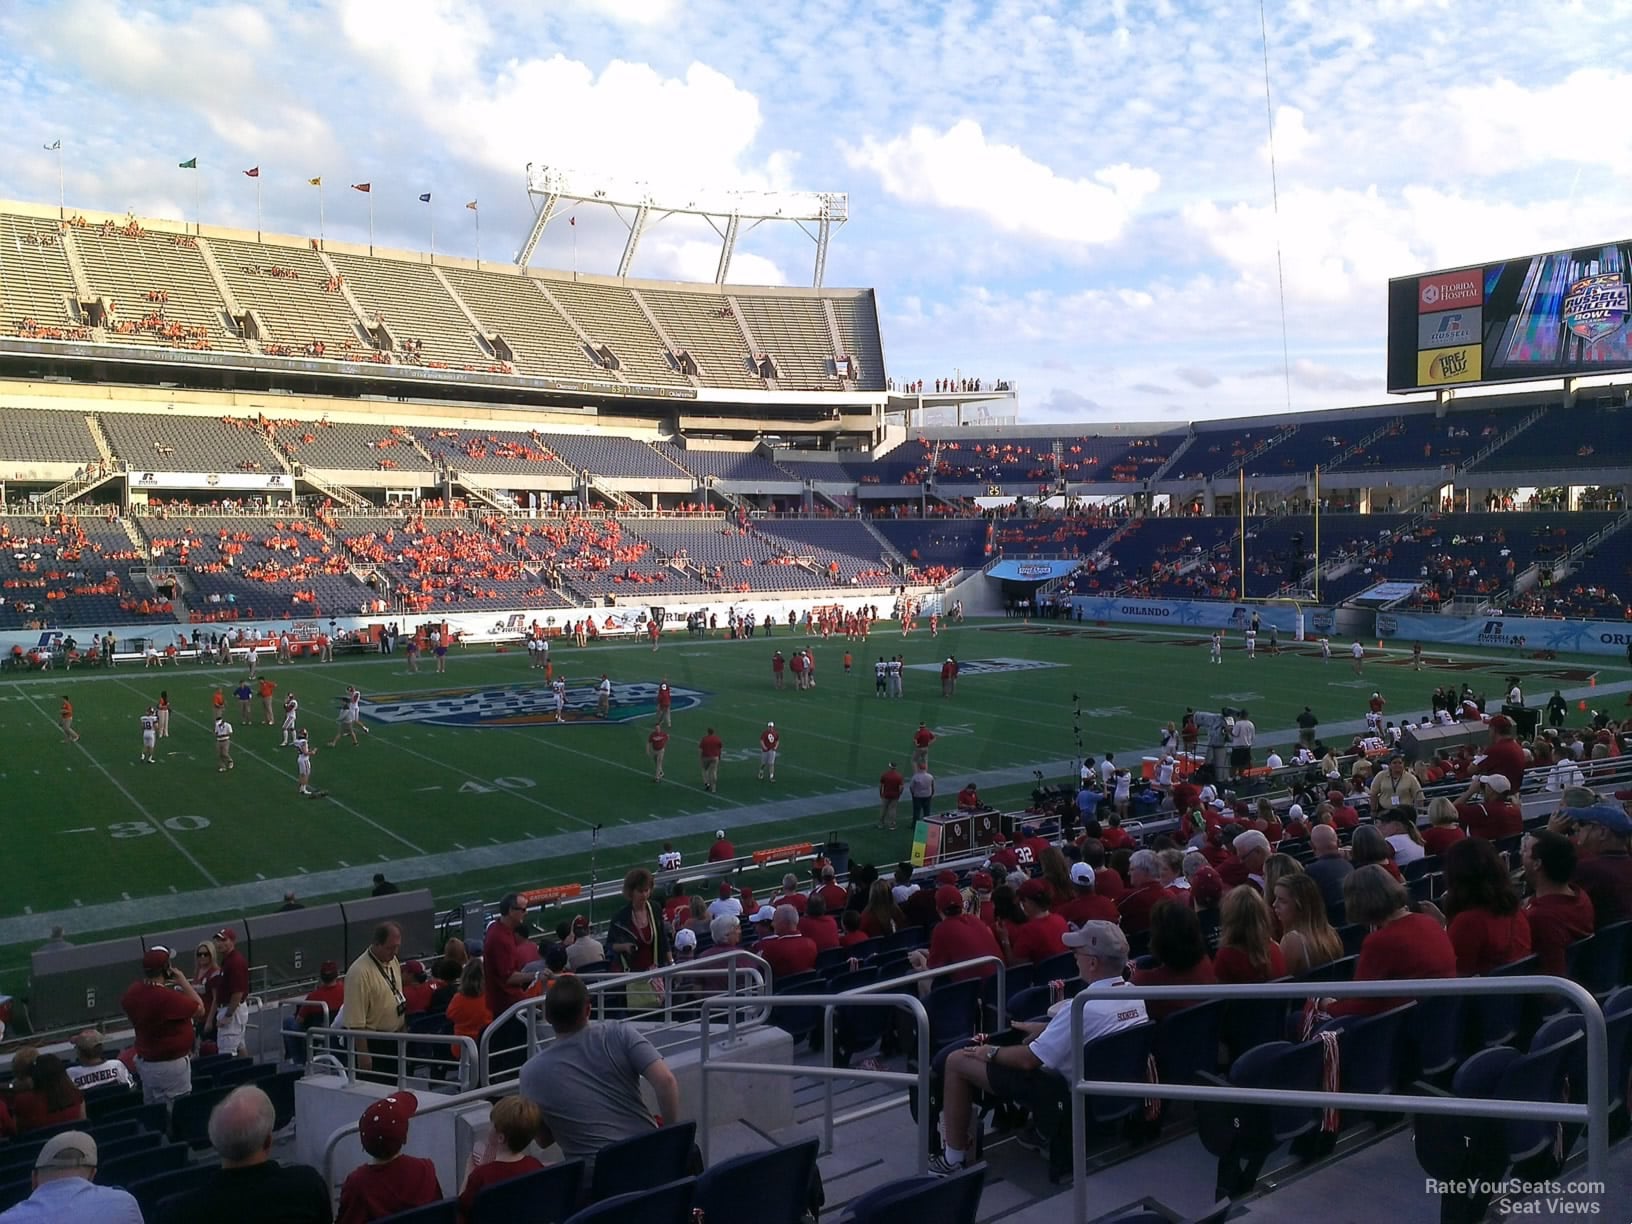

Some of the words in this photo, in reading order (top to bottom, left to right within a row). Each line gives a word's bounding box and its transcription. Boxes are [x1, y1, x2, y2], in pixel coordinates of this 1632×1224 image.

[1441, 282, 1474, 293] FLORIDA
[1441, 289, 1478, 300] HOSPITAL
[1566, 291, 1625, 308] RUSSELL
[1566, 299, 1626, 314] ATHLETIC
[1574, 310, 1611, 321] BOWL
[1432, 331, 1469, 339] RUSSELL
[1439, 350, 1466, 367] TIRES
[1443, 360, 1467, 376] PLUS
[1121, 606, 1170, 617] ORLANDO
[108, 815, 210, 838] 30
[1015, 847, 1034, 864] 32
[1118, 1009, 1139, 1021] SOONERS
[75, 1068, 118, 1086] SOONERS
[1234, 1117, 1240, 1128] S
[1463, 1135, 1472, 1148] T
